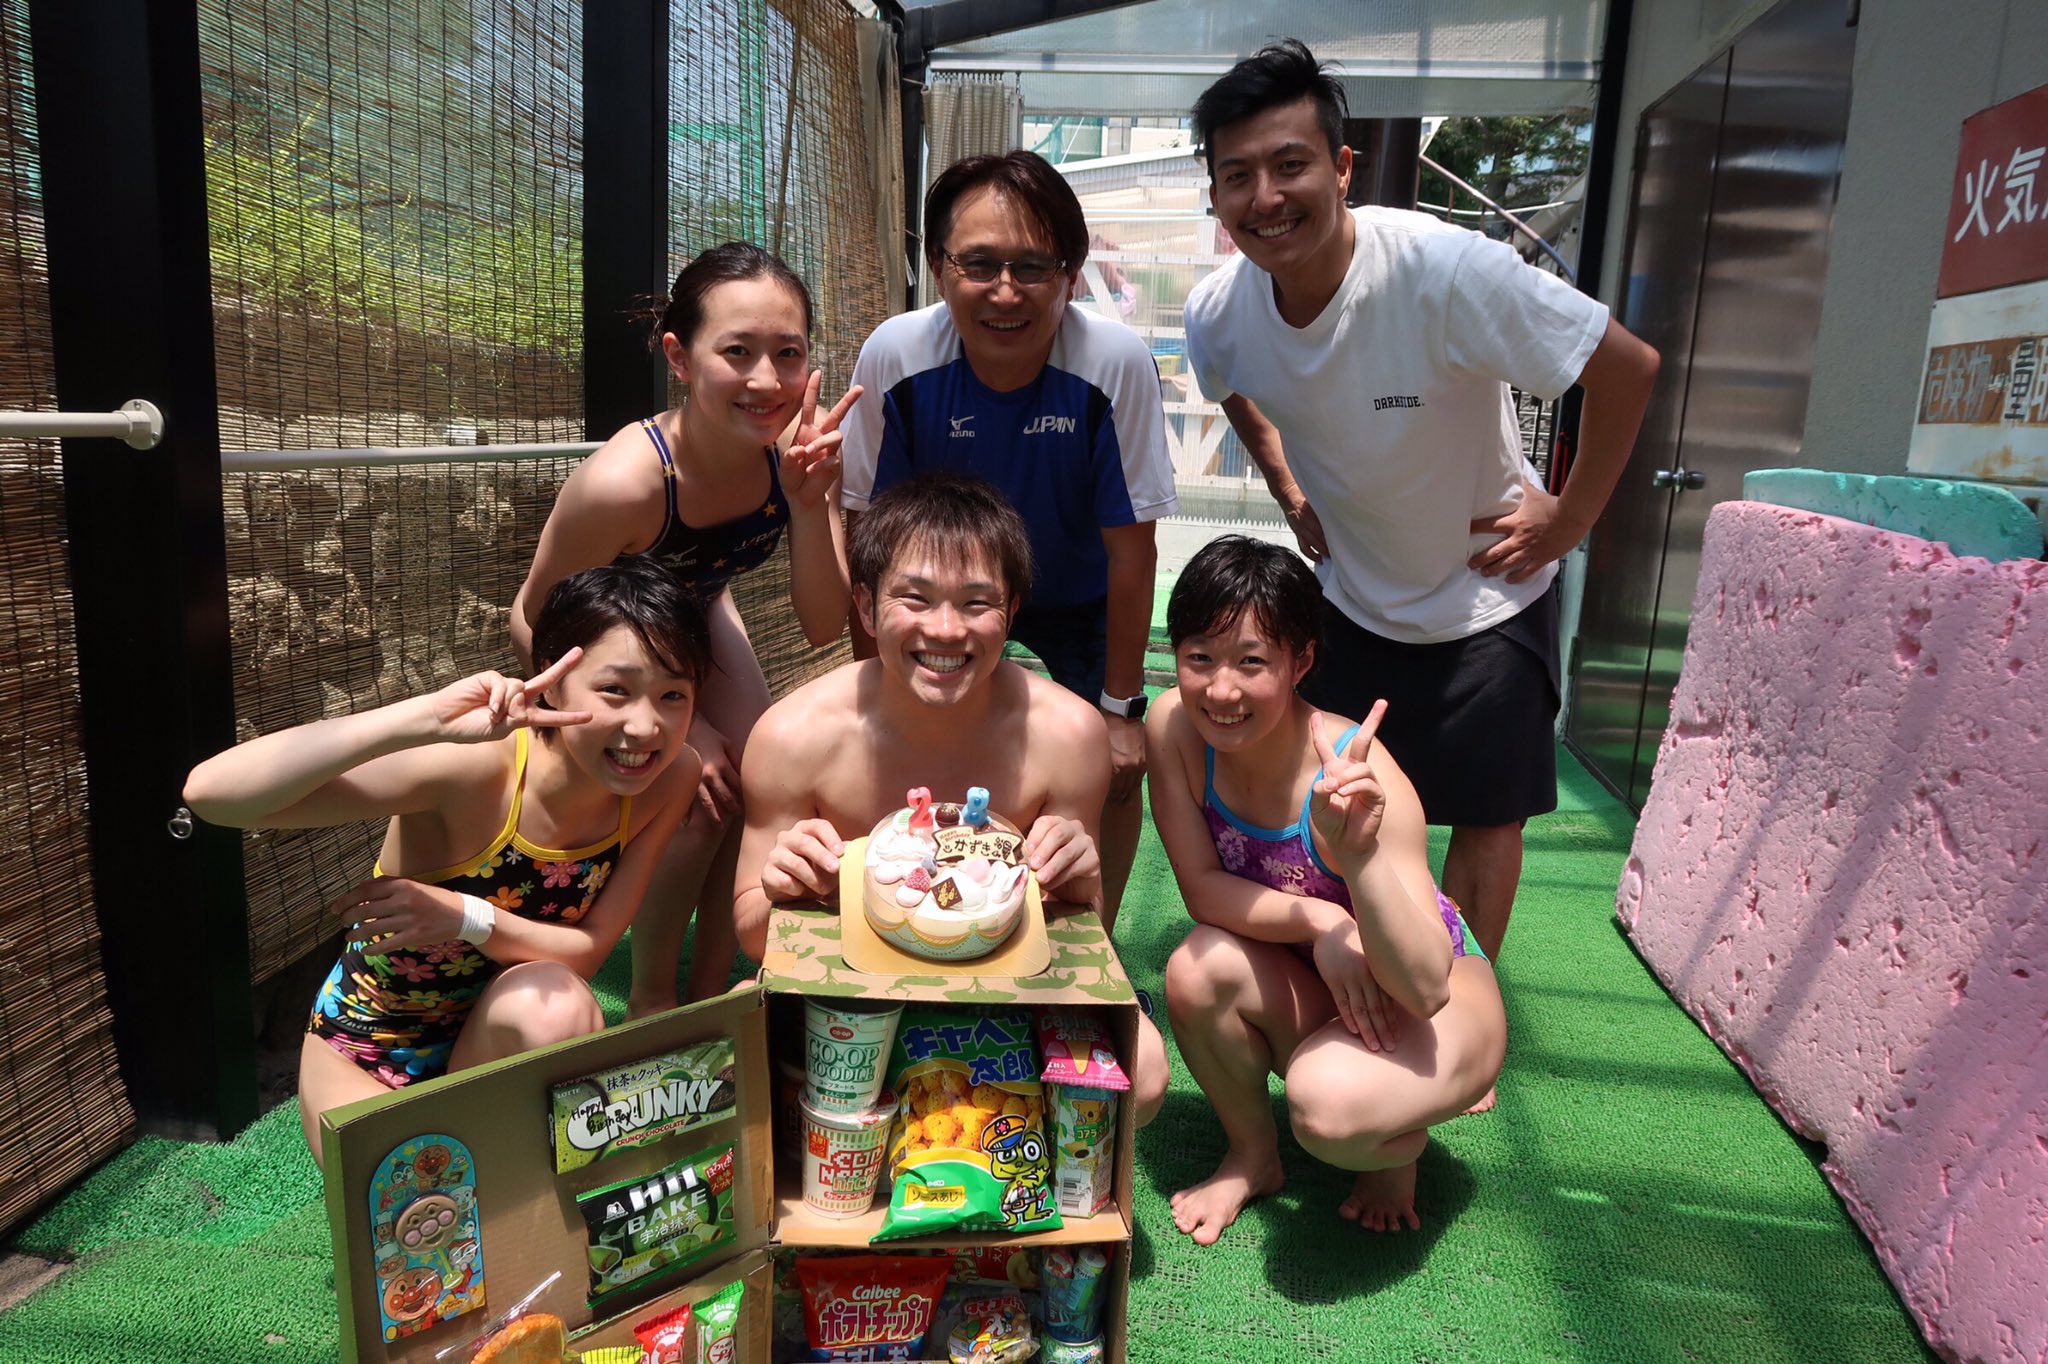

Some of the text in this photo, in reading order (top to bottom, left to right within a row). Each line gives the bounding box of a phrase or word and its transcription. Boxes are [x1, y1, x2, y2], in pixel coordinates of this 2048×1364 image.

[1954, 146, 2048, 243] 火気
[1023, 415, 1076, 434] JPAN
[954, 839, 990, 857] かずき
[902, 1010, 1036, 1062] キャベ
[968, 1049, 1034, 1086] 太郎
[557, 1088, 581, 1099] LOTTE
[567, 1079, 723, 1150] CRUNKY
[616, 1130, 645, 1147] CRUNCH
[645, 1119, 686, 1137] CHOCOLATE
[628, 1188, 707, 1235] BAKE
[912, 1188, 962, 1203] ソースあじ
[640, 1209, 699, 1245] 宇治抹茶
[852, 1285, 901, 1300] Calbee
[819, 1294, 933, 1345] ポテトチップス
